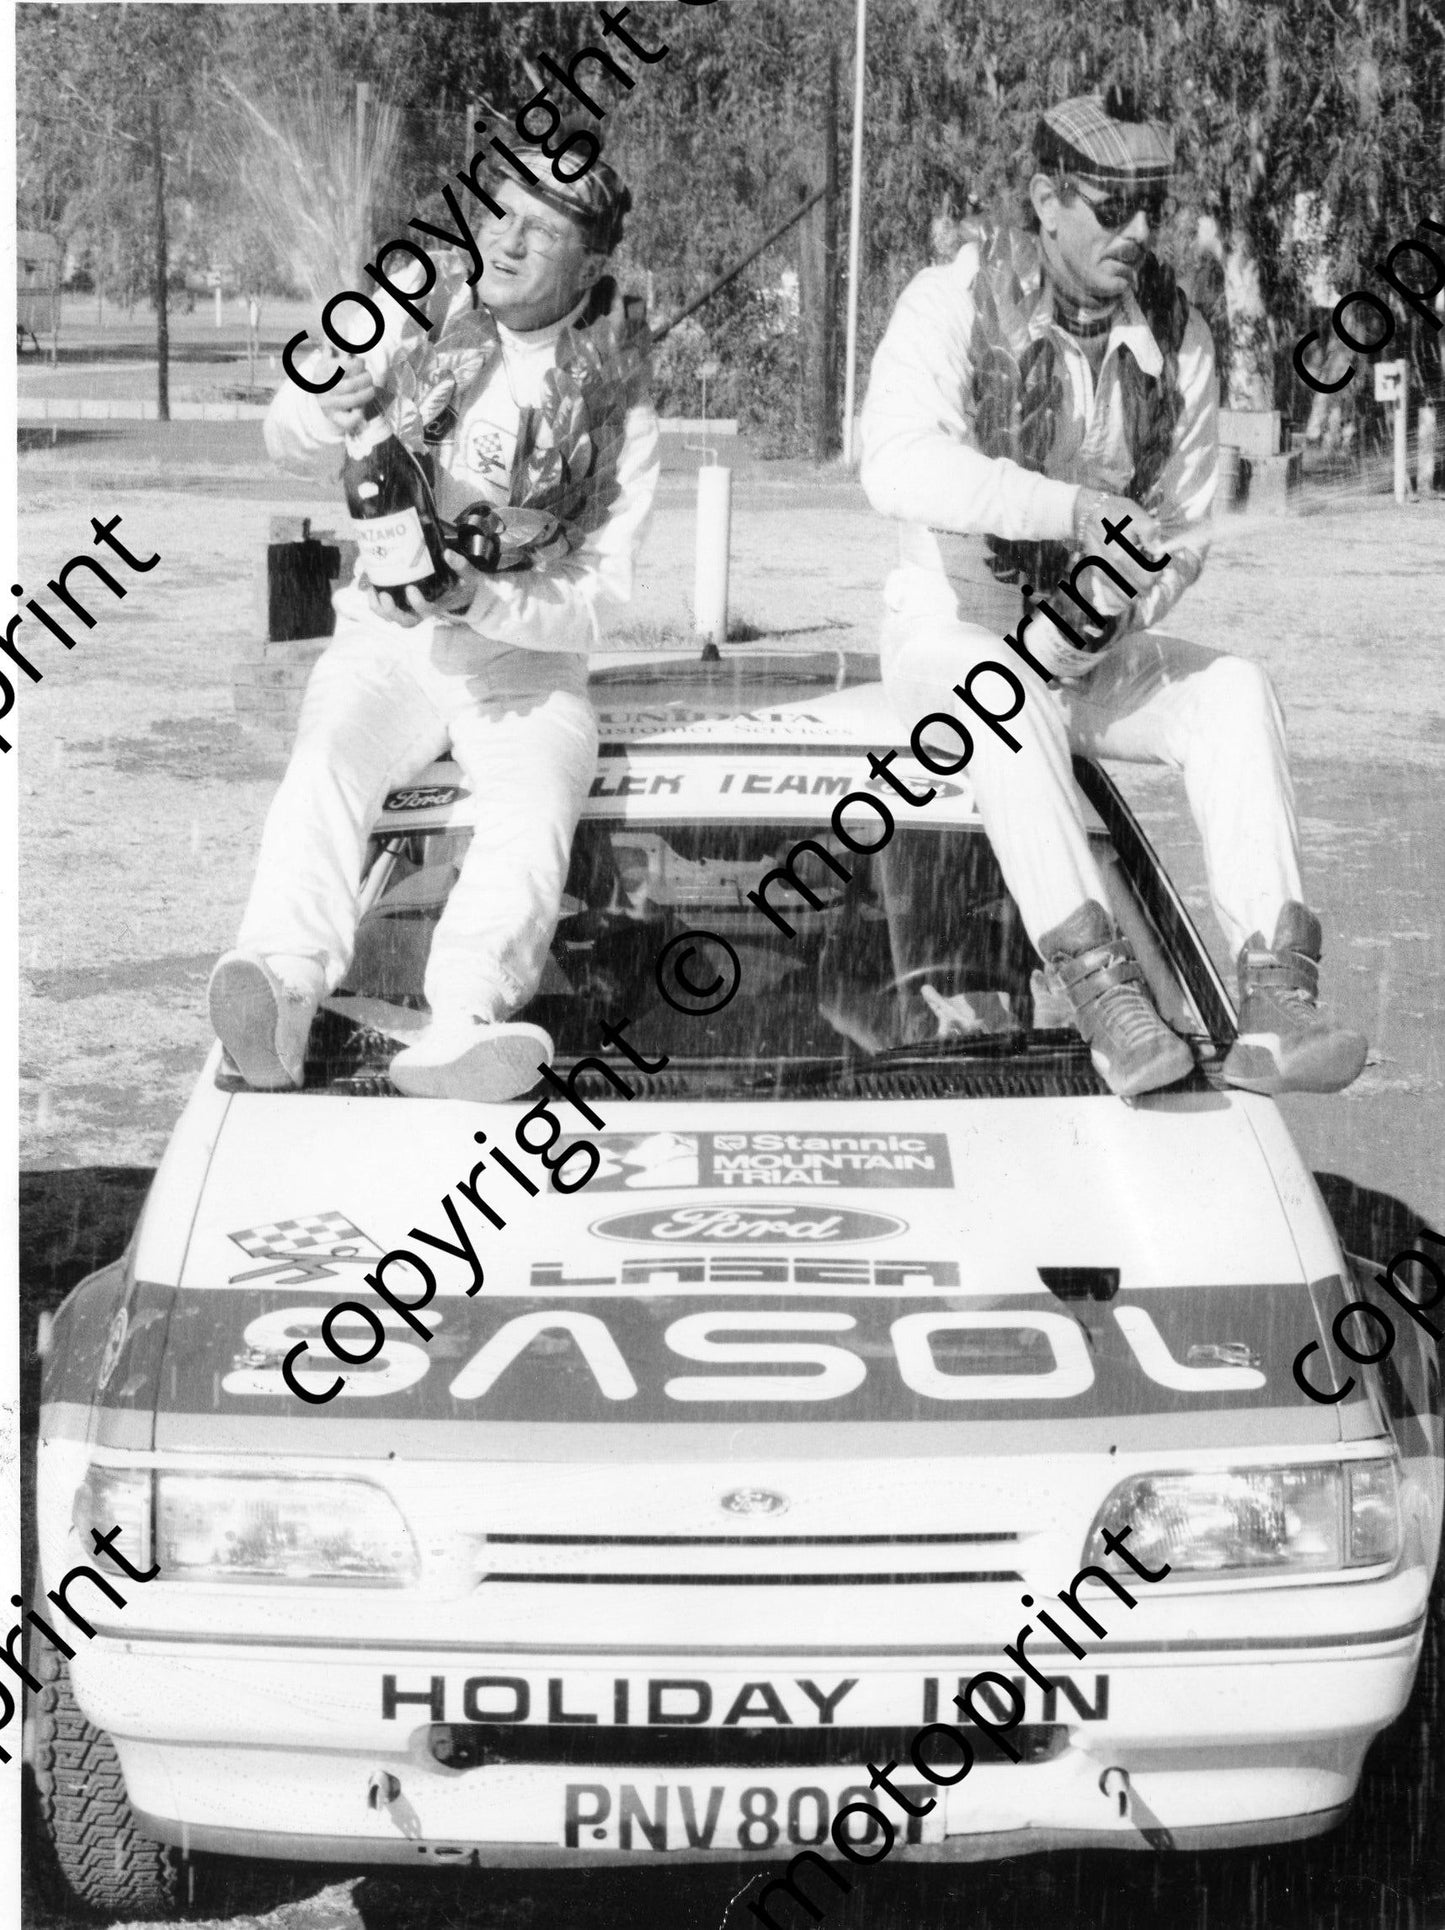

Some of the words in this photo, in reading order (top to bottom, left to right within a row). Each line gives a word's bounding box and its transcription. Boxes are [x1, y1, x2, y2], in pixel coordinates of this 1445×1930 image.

[597, 726, 714, 735] ustomer
[388, 788, 454, 809] Ford
[752, 1134, 927, 1152] Stannic
[713, 1154, 935, 1170] MOUNTAIN
[713, 1169, 840, 1185] TRIAL
[651, 1207, 843, 1239] Ford
[222, 1304, 1266, 1400] SASOL
[381, 1674, 860, 1725] HOLIDAY
[922, 1674, 1110, 1724] INN
